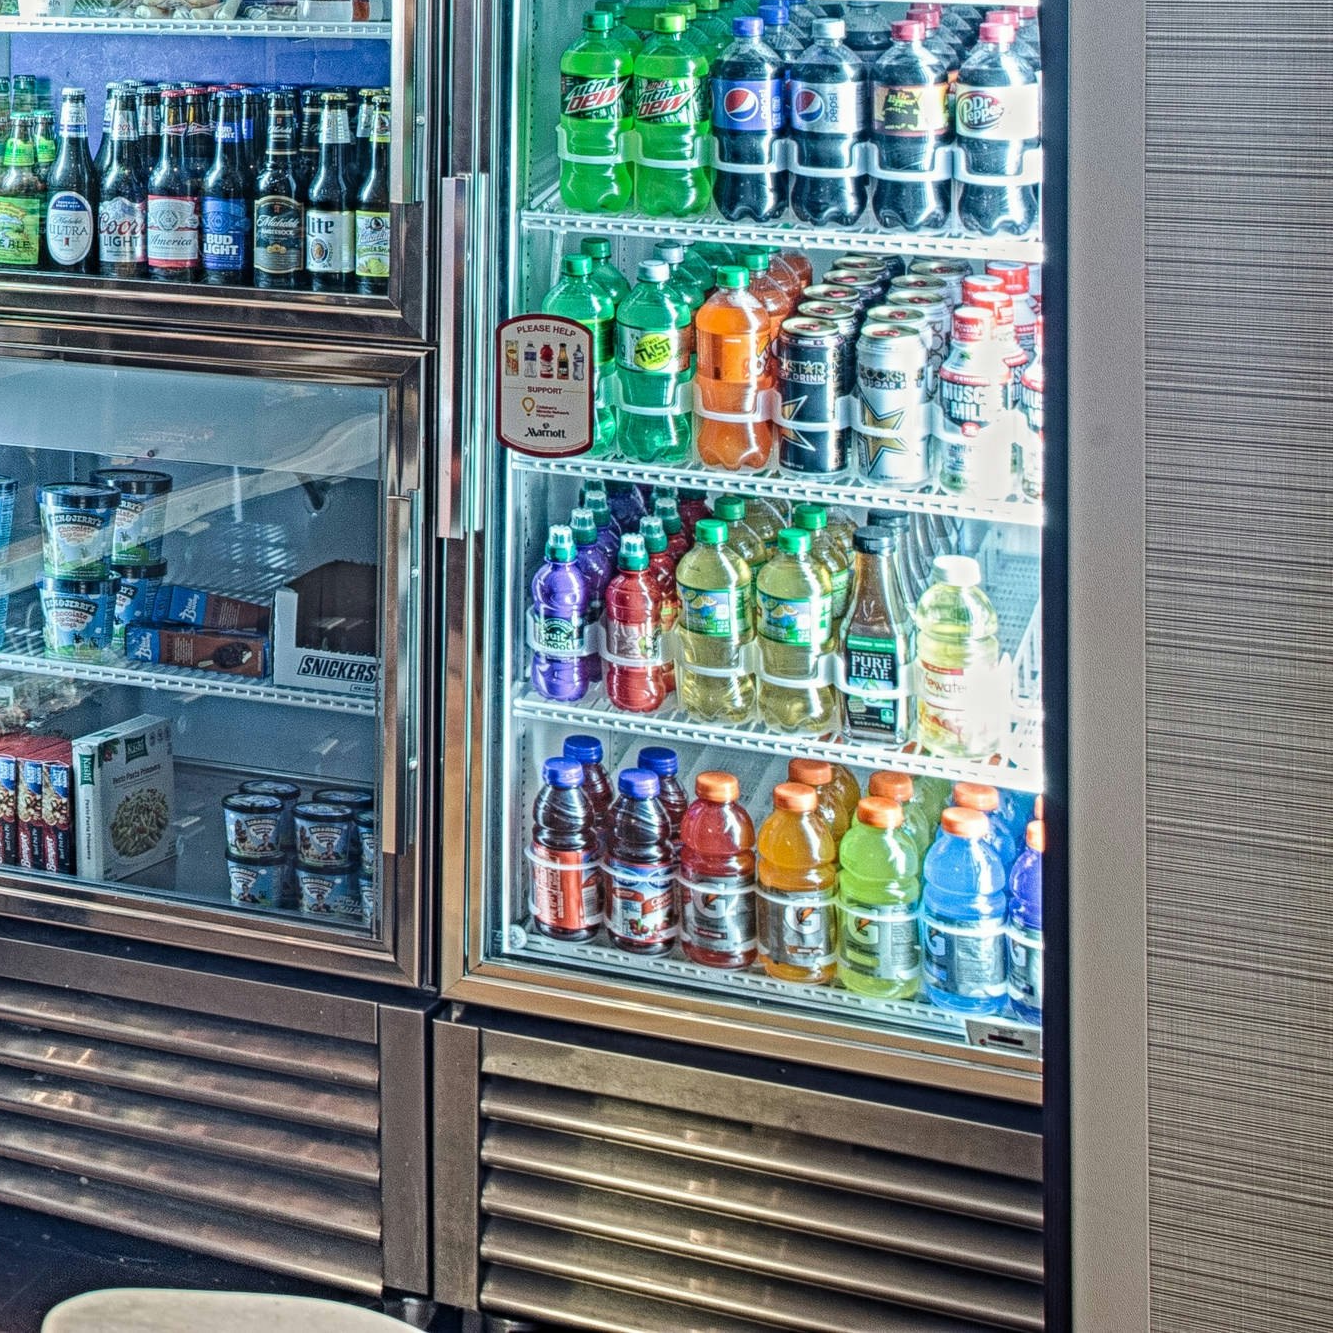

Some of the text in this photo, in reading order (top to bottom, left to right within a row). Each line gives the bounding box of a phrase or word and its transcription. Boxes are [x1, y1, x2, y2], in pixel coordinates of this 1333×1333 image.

[50, 223, 89, 236] ULTRA
[306, 216, 334, 236] Lite
[102, 235, 141, 248] LIGHT
[206, 235, 233, 245] BUD
[203, 244, 239, 255] LIGHT
[516, 325, 576, 337] PLEASE HELP
[527, 385, 563, 395] SUPPORT
[524, 427, 567, 439] Marriott
[300, 655, 377, 683] SNICKERS
[851, 655, 893, 670] PURE
[851, 666, 891, 681] LEAF
